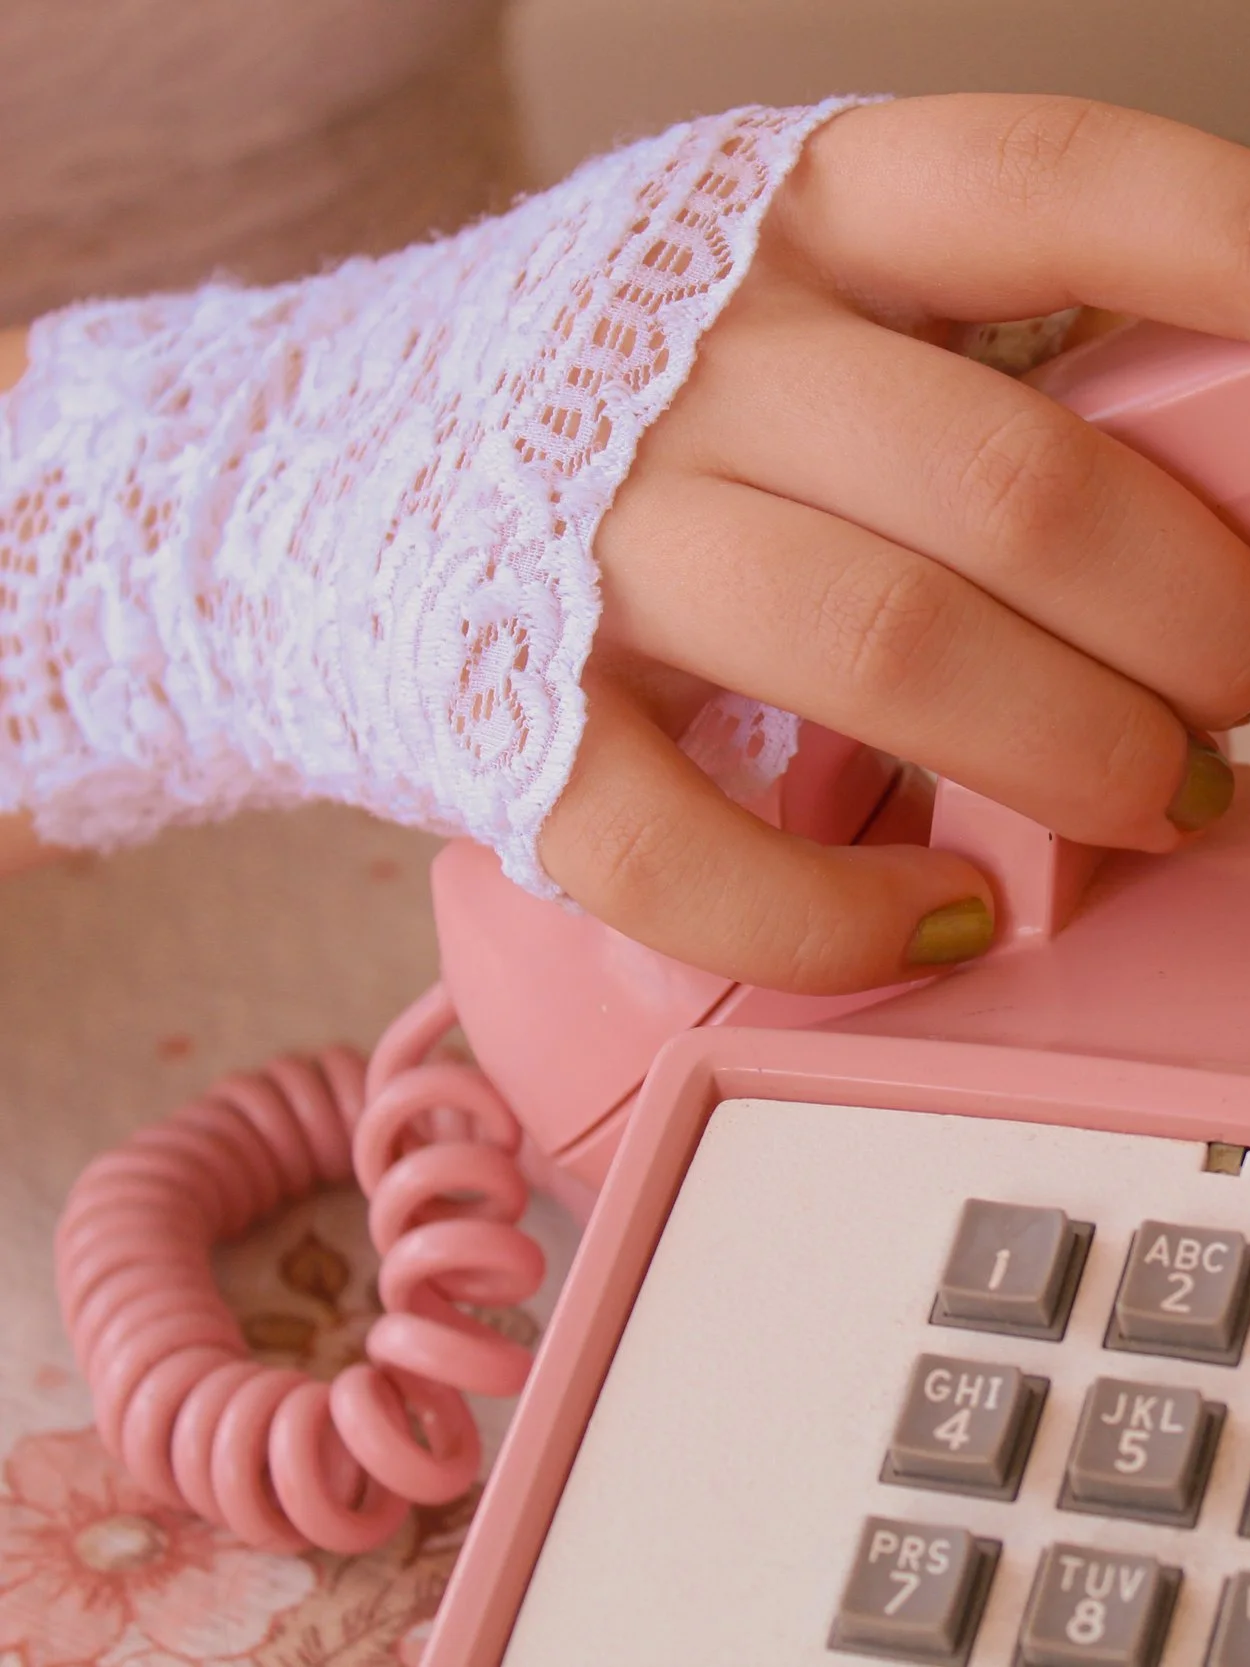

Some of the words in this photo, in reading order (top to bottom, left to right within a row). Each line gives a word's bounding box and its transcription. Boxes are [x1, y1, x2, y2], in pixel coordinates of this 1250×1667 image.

[988, 1249, 1010, 1291] 1
[1144, 1234, 1228, 1273] ABC
[1160, 1273, 1194, 1314] 2
[923, 1368, 1003, 1410] GHI
[933, 1409, 971, 1451] 4
[1101, 1391, 1184, 1434] JKL
[1113, 1430, 1150, 1473] 5
[868, 1530, 951, 1575] PRS
[884, 1572, 919, 1615] 7
[1059, 1555, 1147, 1599] TUV
[1066, 1600, 1105, 1644] 8
